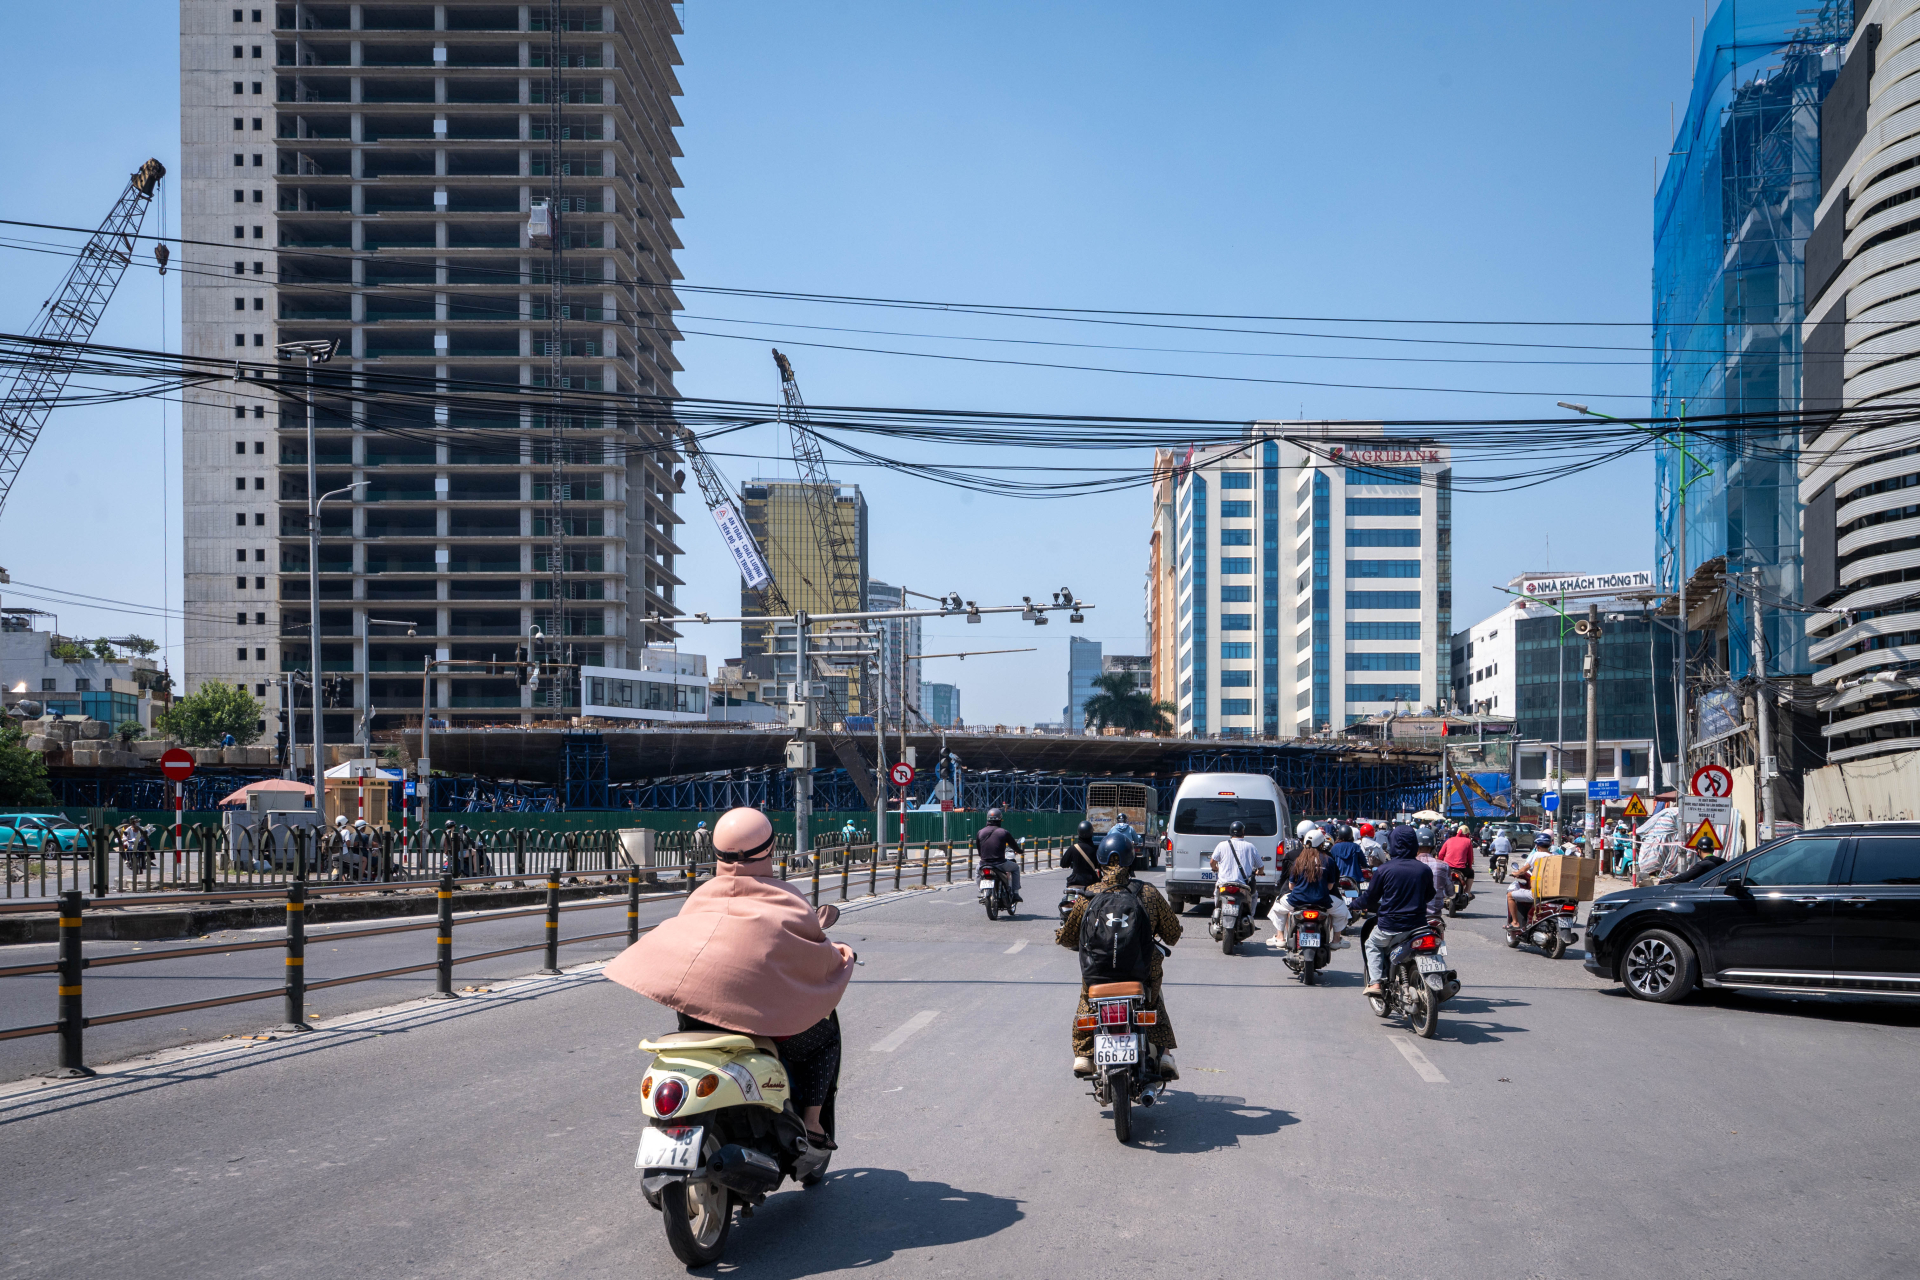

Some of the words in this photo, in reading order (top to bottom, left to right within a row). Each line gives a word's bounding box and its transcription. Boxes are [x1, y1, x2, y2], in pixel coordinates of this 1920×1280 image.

[1350, 450, 1440, 462] AGRIBANK
[727, 516, 736, 526] AN
[1537, 579, 1558, 593] NHÀ
[1560, 577, 1595, 591] KHÁCH
[1597, 574, 1631, 588] THÔNG
[1098, 1049, 1135, 1062] 666.28
